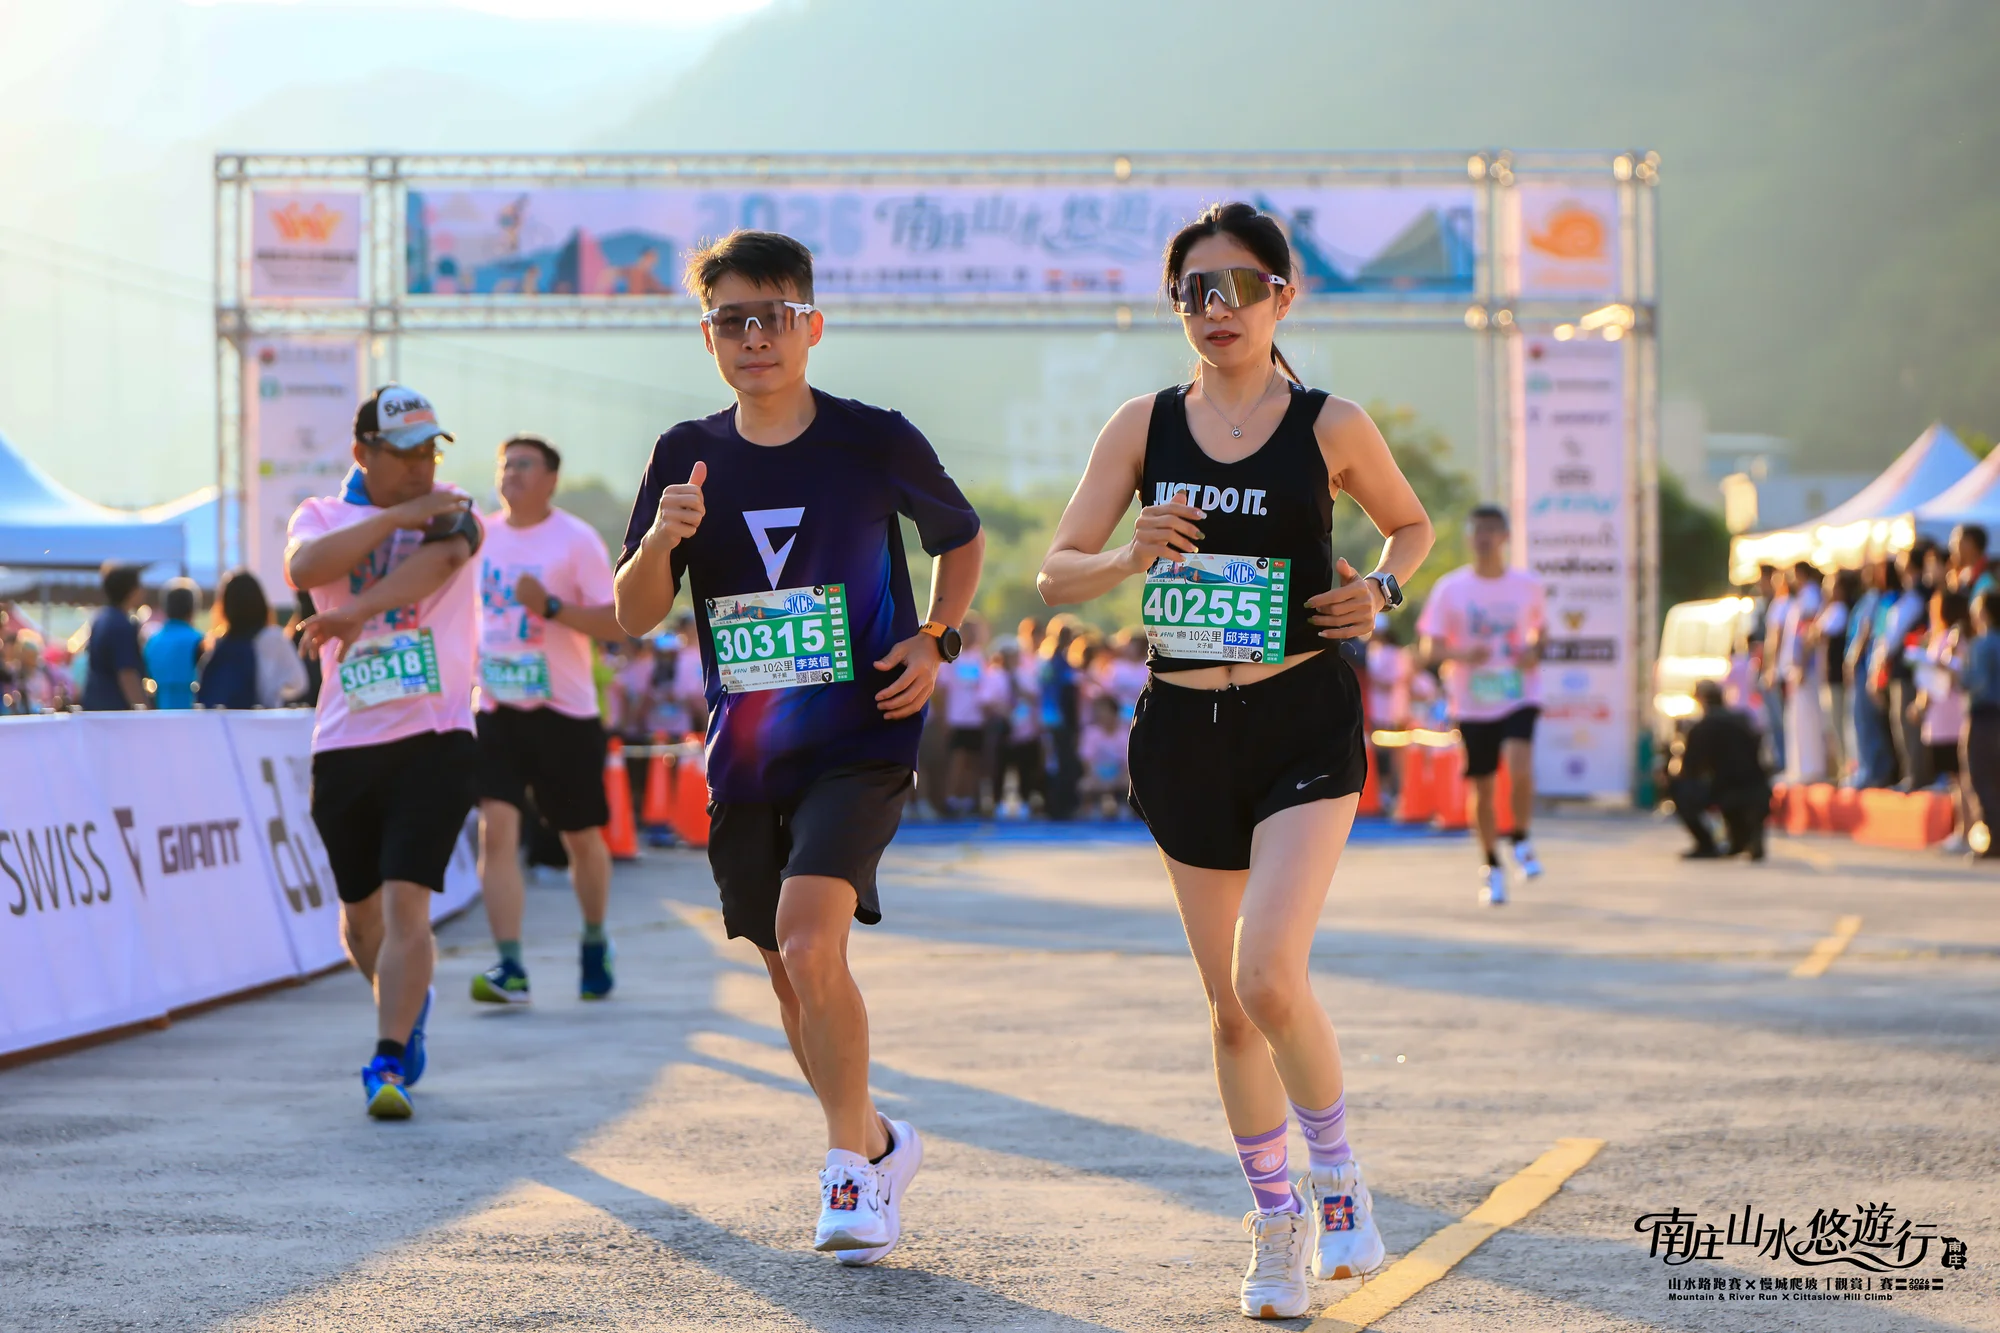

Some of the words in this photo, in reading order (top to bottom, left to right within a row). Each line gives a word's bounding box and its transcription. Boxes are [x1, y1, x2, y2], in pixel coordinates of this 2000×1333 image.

[1202, 485, 1239, 514] DO
[1242, 488, 1268, 516] IT.
[1225, 564, 1255, 583] JKCR
[786, 595, 814, 614] JKCR
[1143, 587, 1261, 627] 40255
[716, 618, 826, 662] 30315
[1189, 630, 1222, 643] 10公里
[1225, 631, 1262, 646] 邱芳青
[343, 650, 423, 692] 30518
[763, 659, 794, 673] 10公里
[796, 656, 831, 670] 李英信
[157, 818, 241, 874] GIANT
[0, 820, 112, 916] SWISS
